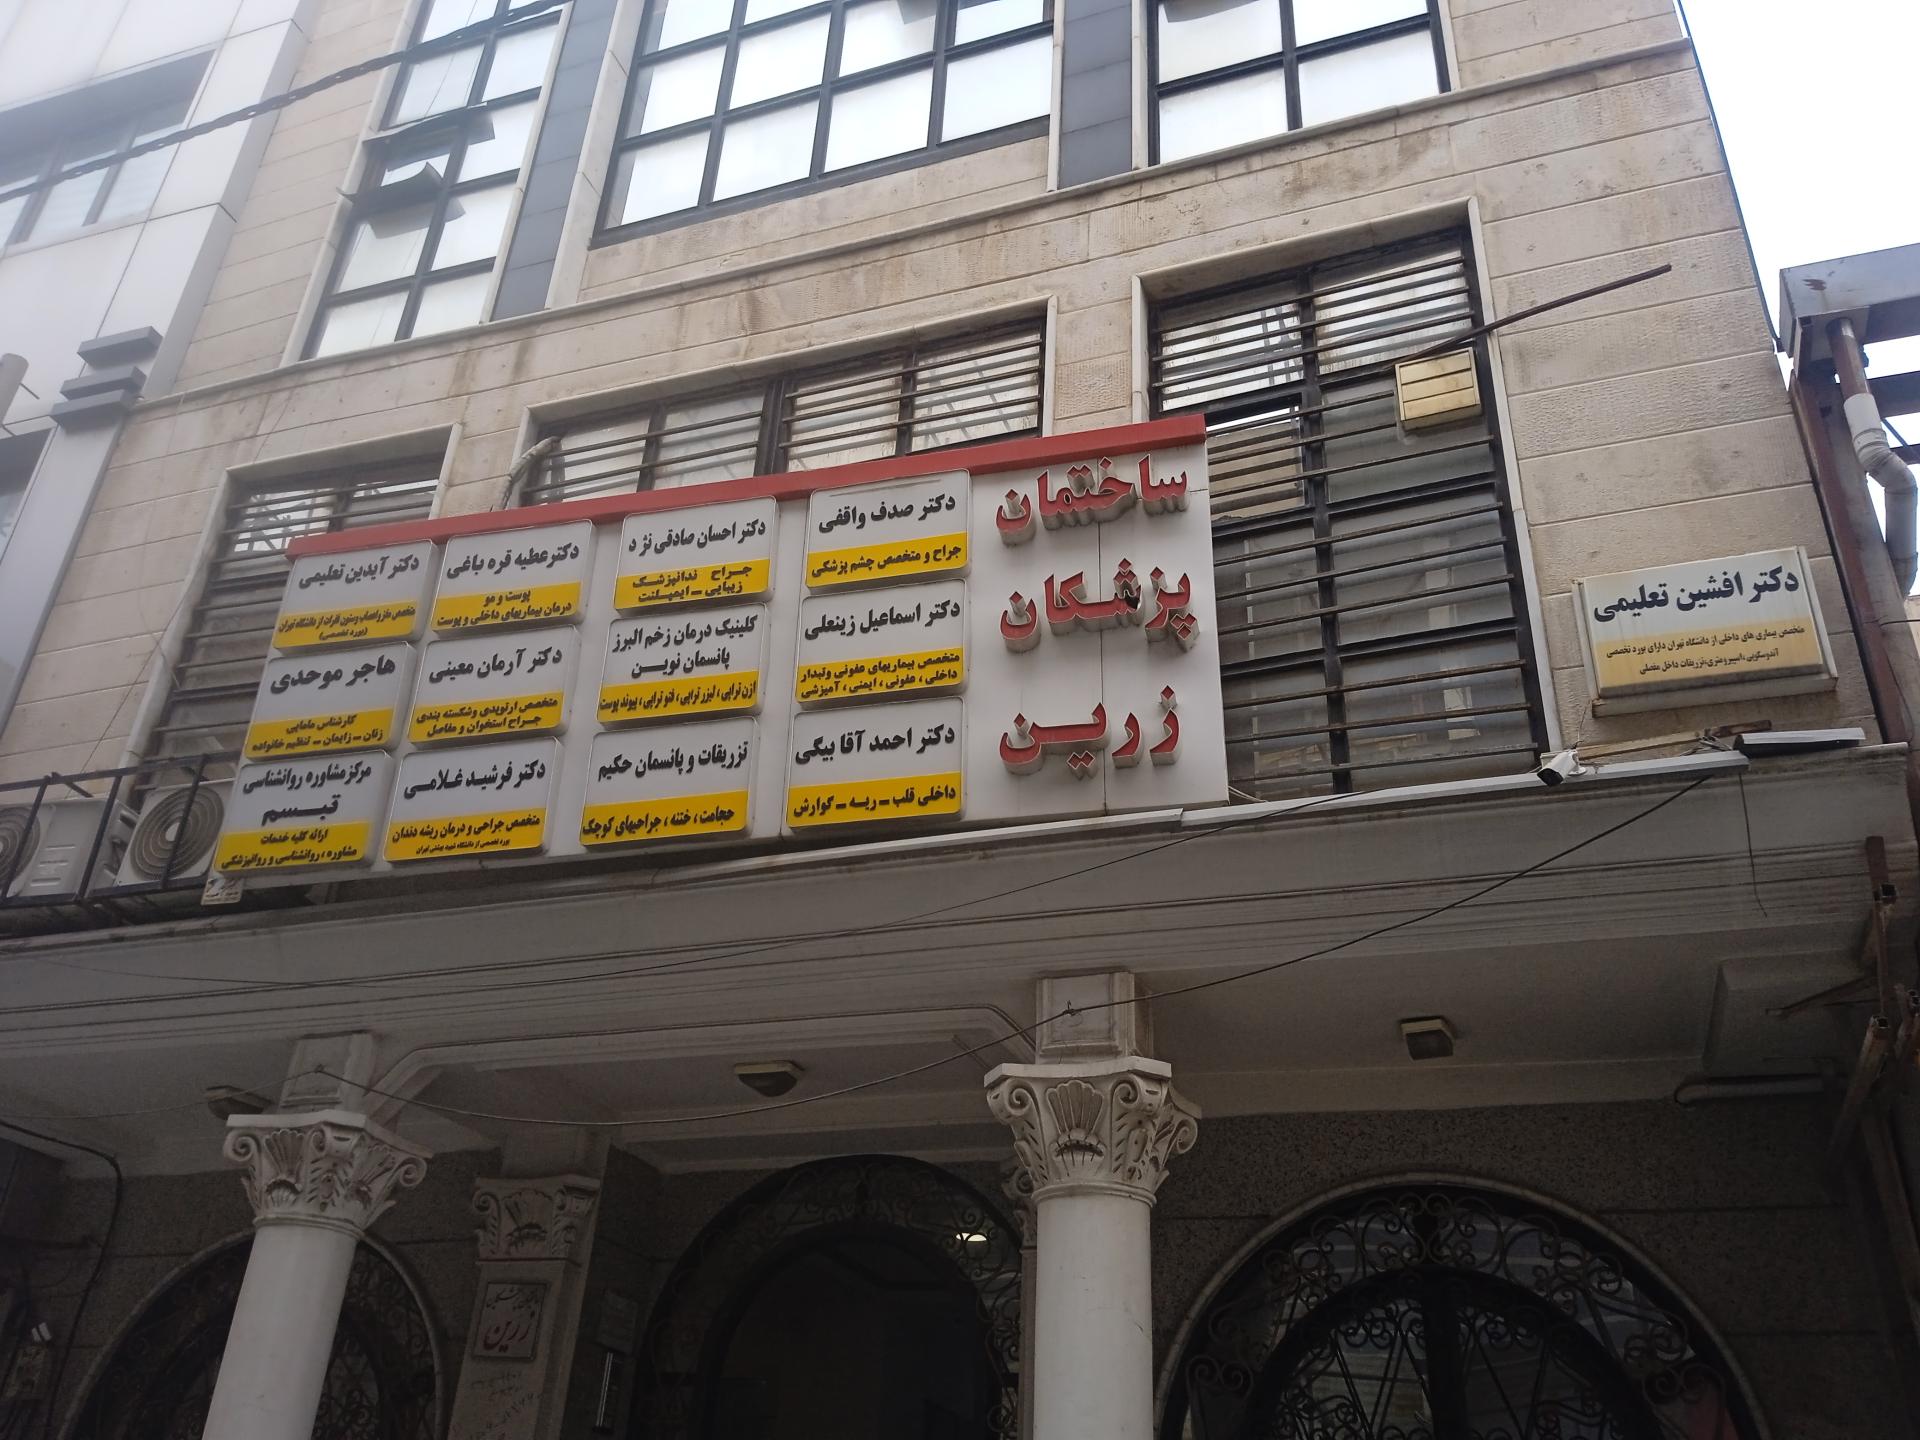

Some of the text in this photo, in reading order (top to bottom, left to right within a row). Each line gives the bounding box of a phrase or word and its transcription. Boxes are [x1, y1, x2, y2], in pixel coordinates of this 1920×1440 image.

[818, 494, 956, 533] دکتر صدف واقفی
[995, 454, 1188, 540] ساختمان
[654, 528, 695, 554] صادقی
[697, 521, 737, 549] احسان
[737, 519, 766, 544] دکتر
[299, 554, 420, 589] دکتر آیدین تعلیمی
[447, 542, 580, 579] دکتر عطیه قره باغی
[812, 544, 962, 578] جراح و متخصص چشم پزشکی
[483, 590, 531, 607] پوست و مو
[638, 581, 743, 603] زیبایی ایمپلنت
[999, 557, 1198, 646] پزشکان
[1594, 566, 1800, 622] دکتر افشین تعلیمی
[437, 602, 572, 628] درمان بیماریهای داخلی و پوست
[804, 600, 961, 640] دکتر اسماعیل زینعلی
[612, 615, 758, 653] کلینیک درمان زخم البرز
[270, 655, 396, 694] هاجر موحدی
[429, 647, 563, 683] دکتر آرمان معینی
[631, 647, 730, 678] پانسمان نوین
[834, 664, 865, 679] عفونی
[868, 658, 915, 675] بیماریهای
[918, 653, 960, 669] متخصص
[427, 715, 542, 738] جراح استخوان و مفاصل
[999, 684, 1181, 776] زرین
[598, 741, 748, 782] تزریقات و پانسمان حکیم
[795, 724, 955, 765] دکتر احمد آقا بیگی
[242, 761, 372, 794] مرکز مشاوره روانشناسی
[404, 759, 546, 799] دکتر فرشید غلامی
[793, 784, 956, 817] داخلی قلب ریه گوارش
[392, 814, 540, 843] متخصص جراحی و درمان ریشه دندان
[582, 805, 735, 839] حجامت ختنه جراحیهای کوچک
